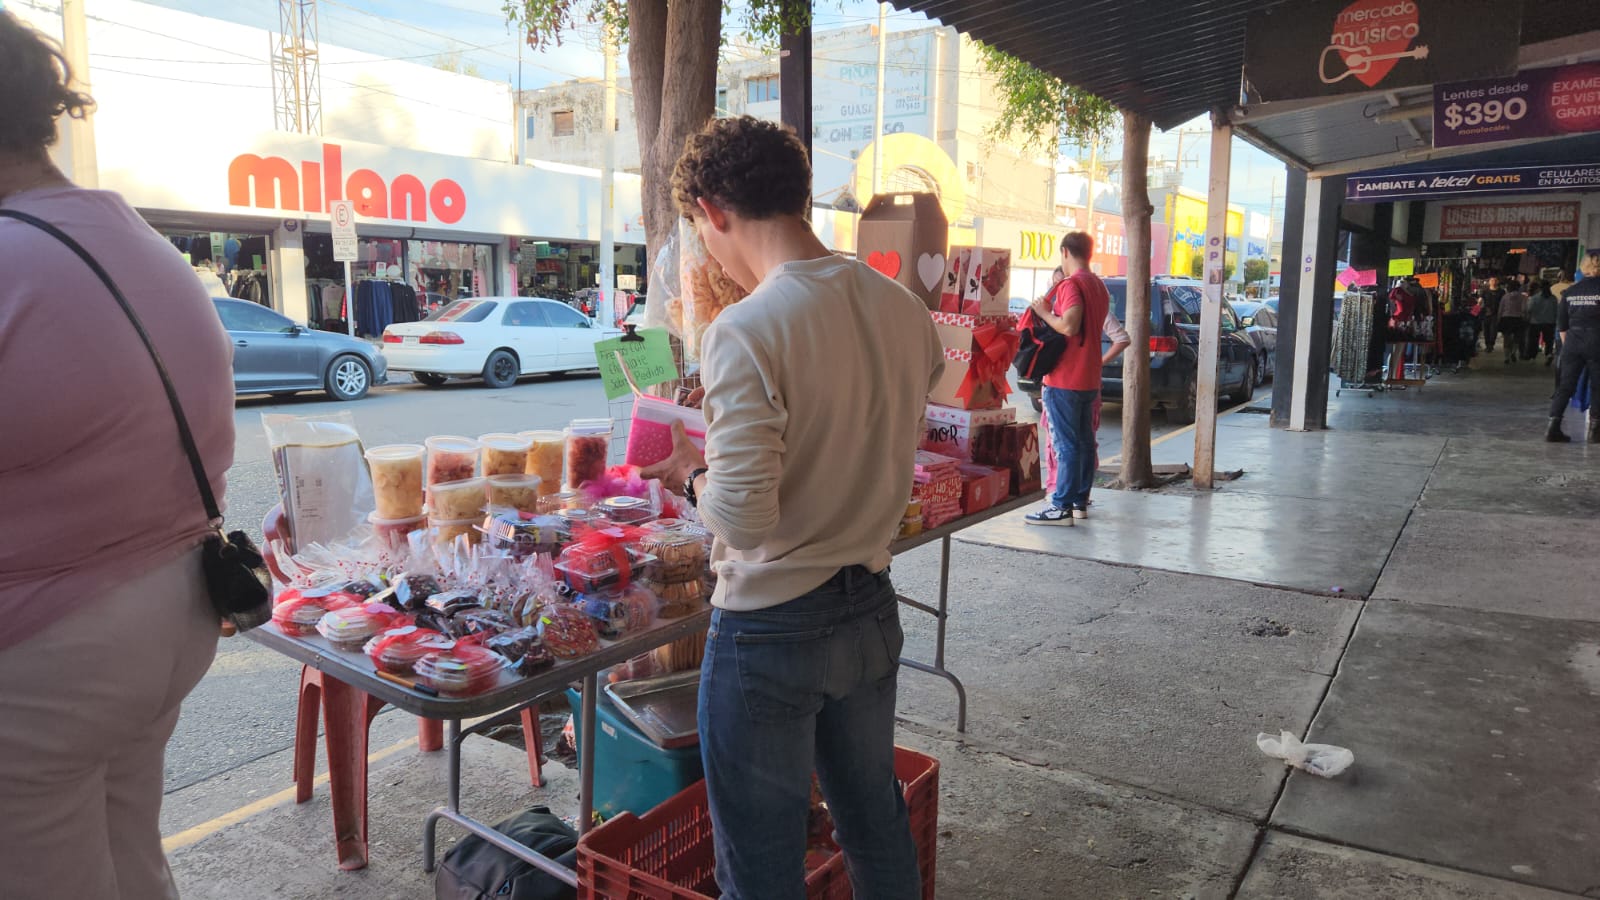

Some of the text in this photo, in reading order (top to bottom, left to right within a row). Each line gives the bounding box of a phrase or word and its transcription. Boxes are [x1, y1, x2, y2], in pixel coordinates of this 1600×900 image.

[1337, 1, 1416, 24] mercado
[1331, 23, 1420, 46] músico
[1442, 82, 1529, 102] Lentes desde
[1551, 94, 1570, 106] DE
[1444, 96, 1527, 130] $390
[228, 143, 466, 224] milano
[1356, 174, 1521, 192] CAMBIATE A telcel GRATIS
[1538, 178, 1551, 186] EN
[1539, 168, 1600, 179] CELULARES
[1020, 230, 1056, 261] DUO
